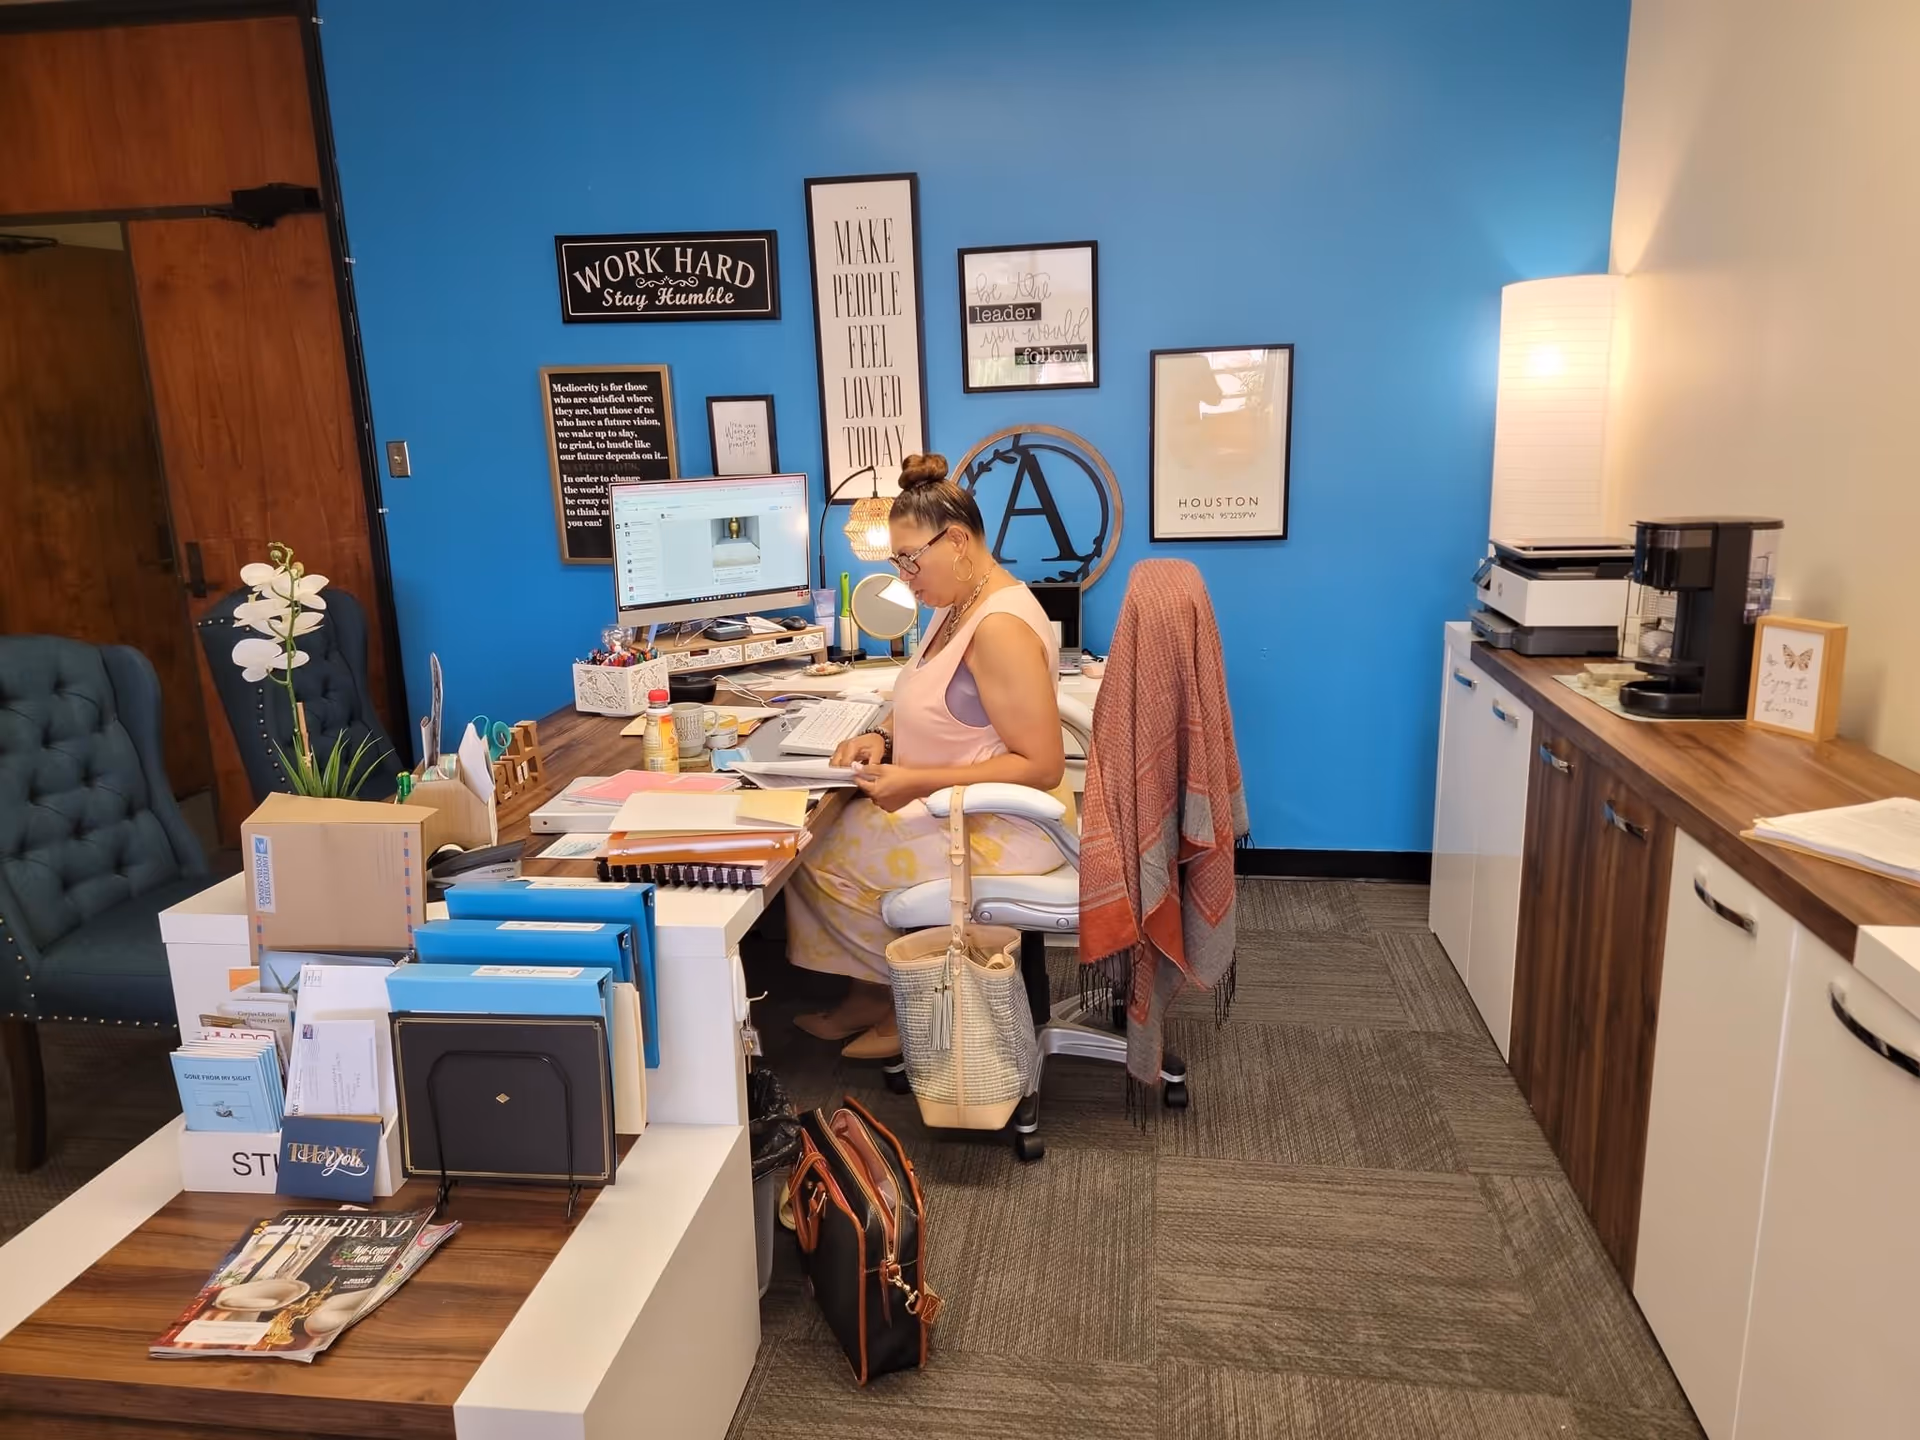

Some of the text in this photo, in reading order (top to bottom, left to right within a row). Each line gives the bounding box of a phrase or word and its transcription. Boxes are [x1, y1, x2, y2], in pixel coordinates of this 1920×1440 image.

[834, 218, 895, 265] MAKE
[573, 247, 755, 293] WORK HARD
[602, 286, 735, 311] Stay Humble
[833, 271, 902, 318] PEOPLE
[975, 305, 1036, 323] leader
[848, 324, 894, 369] FEEL
[1023, 347, 1079, 364] follow
[552, 381, 648, 394] Mediocrity is for those
[554, 394, 653, 404] who are satisfied where
[842, 375, 903, 419] LOVED
[555, 406, 573, 417] they
[574, 408, 592, 416] are,
[593, 406, 608, 415] but
[610, 406, 632, 415] those
[634, 406, 644, 414] of
[556, 418, 575, 427] who
[576, 418, 596, 427] have
[604, 418, 632, 426] future
[632, 417, 660, 427] vision,
[571, 429, 594, 438] wake
[595, 430, 607, 440] up
[608, 430, 617, 438] to
[618, 429, 638, 439] slay,
[559, 442, 568, 450] to
[569, 441, 595, 451] grind,
[606, 440, 633, 449] hustle
[634, 440, 651, 448] like
[842, 425, 906, 468] TODAY
[560, 453, 576, 461] our
[577, 452, 604, 460] future
[606, 452, 641, 462] depends
[642, 452, 653, 460] on
[562, 474, 574, 483] In
[574, 474, 599, 483] order
[564, 486, 578, 494] the
[580, 486, 604, 494] world
[565, 497, 576, 505] be
[577, 498, 600, 506] crazy
[1178, 496, 1259, 508] HOUSTON
[576, 508, 600, 516] think
[567, 519, 602, 528] you can!
[262, 856, 272, 905] UNITED STATES
[288, 1142, 366, 1168] THANK
[334, 1218, 414, 1238] BEND
